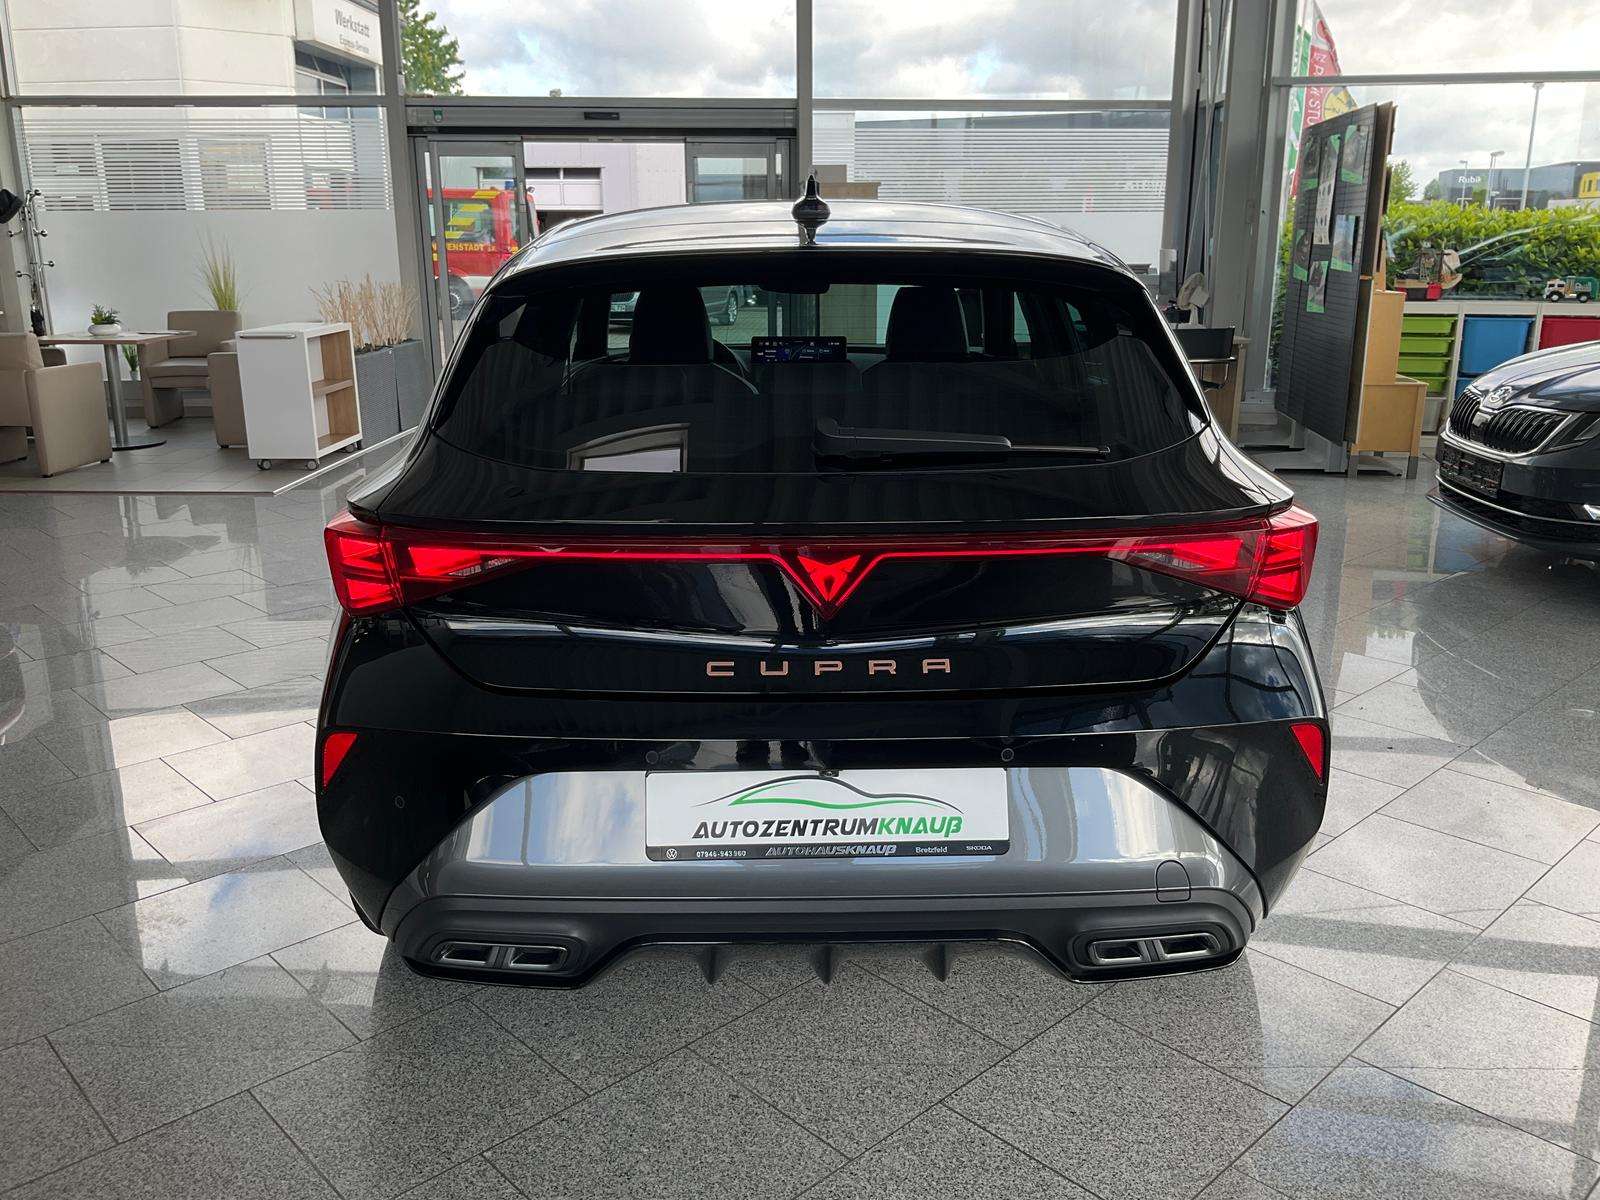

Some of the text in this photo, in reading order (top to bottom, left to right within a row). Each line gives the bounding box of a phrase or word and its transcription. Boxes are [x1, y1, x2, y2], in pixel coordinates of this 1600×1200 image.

[335, 9, 370, 38] Werkstatt
[706, 658, 951, 676] CUPRA
[915, 846, 948, 854] Bretzfeld
